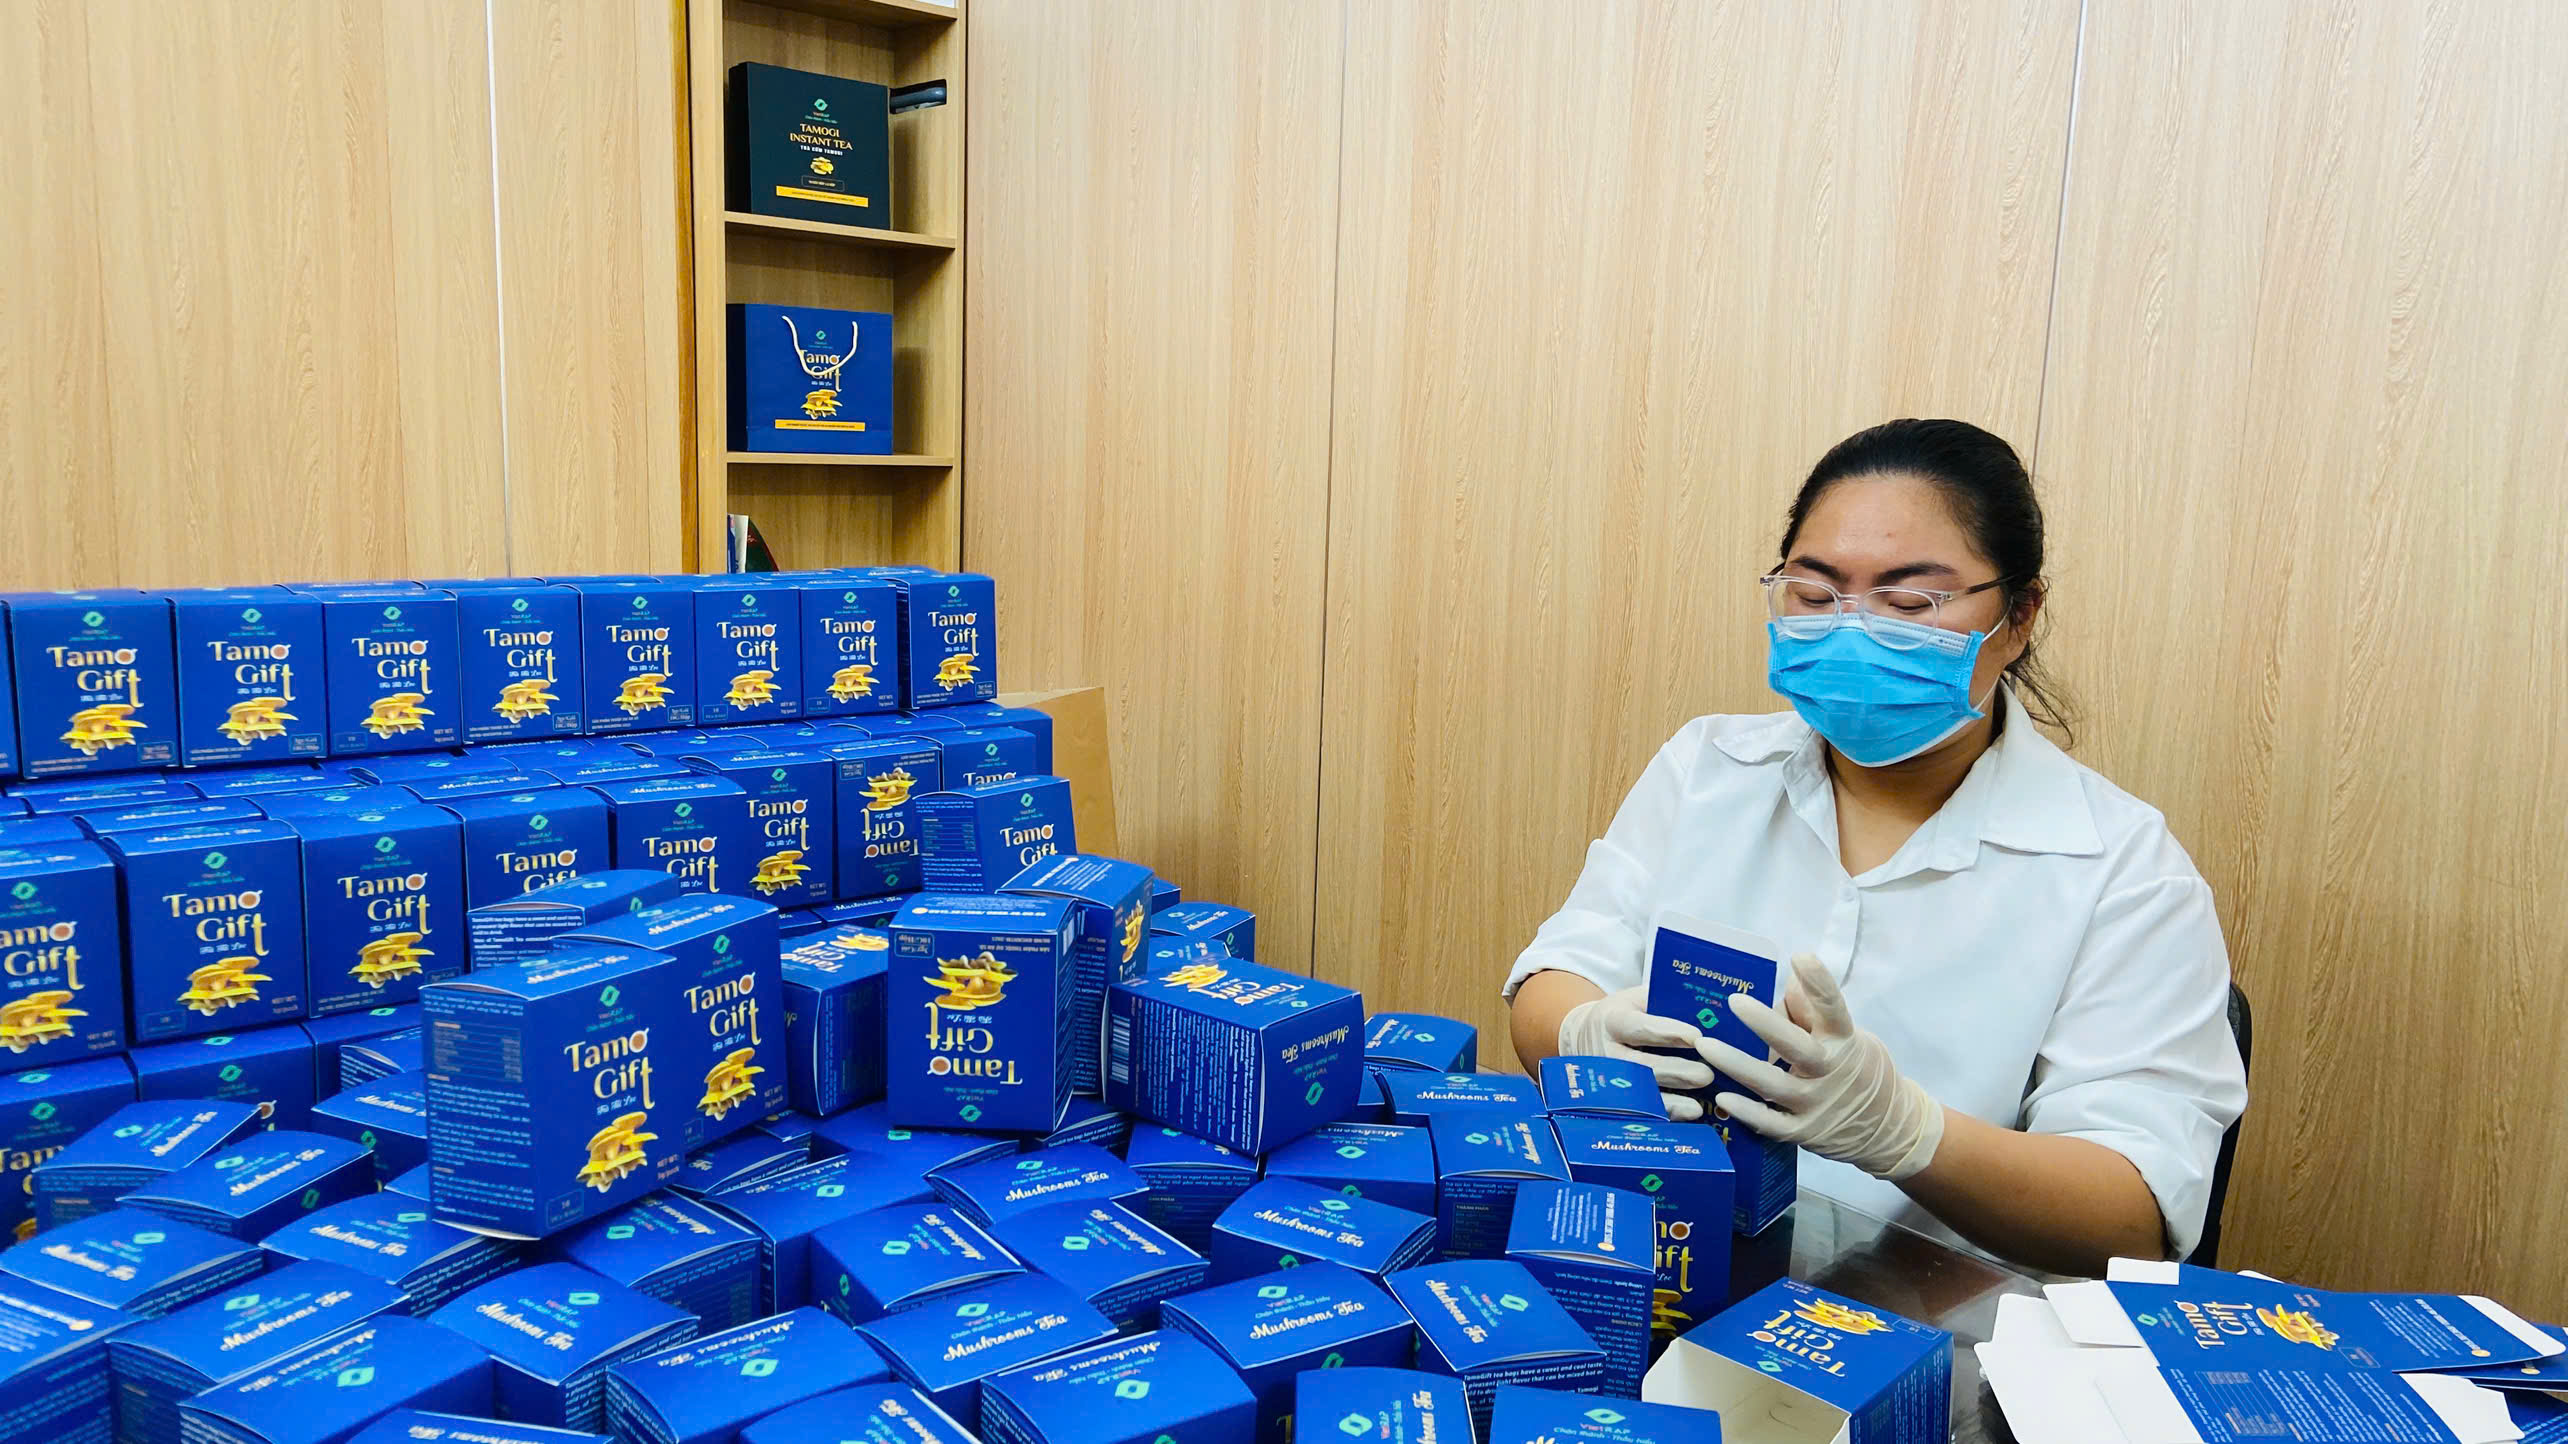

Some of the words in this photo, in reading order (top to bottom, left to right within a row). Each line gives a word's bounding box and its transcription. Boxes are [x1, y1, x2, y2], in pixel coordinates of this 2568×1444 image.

[790, 133, 832, 147] INSTANT
[833, 139, 853, 150] TEA
[800, 123, 840, 138] TAMOGI
[800, 349, 841, 365] Tamo
[716, 621, 777, 638] Tamo
[820, 618, 876, 634] Tamo
[928, 611, 977, 626] Tamo
[352, 637, 429, 657] Tamo
[483, 628, 554, 647] Tamo
[606, 625, 670, 643] Tamo
[943, 628, 979, 656] Gift
[46, 646, 138, 667] Tamo
[207, 641, 292, 661] Tamo
[627, 644, 673, 677] Gift
[736, 640, 780, 672] Gift
[838, 636, 878, 666] Gift
[377, 658, 433, 694] Gift
[507, 648, 558, 683] Gift
[77, 669, 144, 708] Gift
[235, 663, 296, 701] Gift
[746, 799, 809, 818] Tamo
[764, 816, 811, 851] Gift
[861, 808, 904, 841] Gift
[1000, 824, 1054, 847] Tamo
[642, 836, 718, 857] Tamo
[864, 839, 920, 859] Tamo
[496, 849, 578, 873] Tamo
[666, 855, 720, 893] Gift
[337, 872, 428, 899] Tamo
[523, 870, 576, 893] Gif
[162, 890, 263, 918] Tamo
[367, 894, 432, 934] Gift
[0, 921, 78, 949] amo
[196, 913, 269, 956] Gift
[4, 945, 85, 991] Gift
[1672, 959, 1692, 976] Tea
[1694, 966, 1754, 994] Mushrooms
[684, 971, 756, 1014] Tamo
[709, 998, 761, 1045] Gift
[924, 1002, 994, 1054] Gift
[564, 1027, 650, 1073] Tamo
[1300, 1025, 1350, 1052] Mushrooms
[1282, 1044, 1299, 1064] Tea
[593, 1057, 655, 1110] Gift
[927, 1055, 1023, 1085] Tamo
[1417, 1091, 1490, 1102] Mushrooms
[1493, 1093, 1517, 1103] Tea
[1591, 1140, 1669, 1153] Mushrooms
[1674, 1145, 1701, 1155] Tea
[1005, 1179, 1082, 1202] Mushrooms
[1081, 1171, 1109, 1183] Tea
[1253, 1209, 1334, 1240] Mushrooms
[1336, 1231, 1366, 1249] Tea
[1656, 1245, 1694, 1293] ift
[1250, 1311, 1333, 1341] Mushrooms
[1333, 1300, 1365, 1317] Tea
[1763, 1309, 1835, 1351] Gift
[2174, 1299, 2225, 1350] Tamo
[2202, 1301, 2253, 1336] Gift
[944, 1325, 1034, 1362] Mushrooms
[1035, 1314, 1068, 1331] Tea
[1746, 1330, 1846, 1378] Tamo
[1468, 1380, 1495, 1389] pleasant
[1513, 1377, 1530, 1385] flavor
[1531, 1375, 1544, 1383] that
[1566, 1371, 1585, 1379] mixed
[1504, 1370, 1519, 1378] bags
[1542, 1366, 1560, 1374] sweet
[1579, 1422, 1631, 1435] VietRAP
